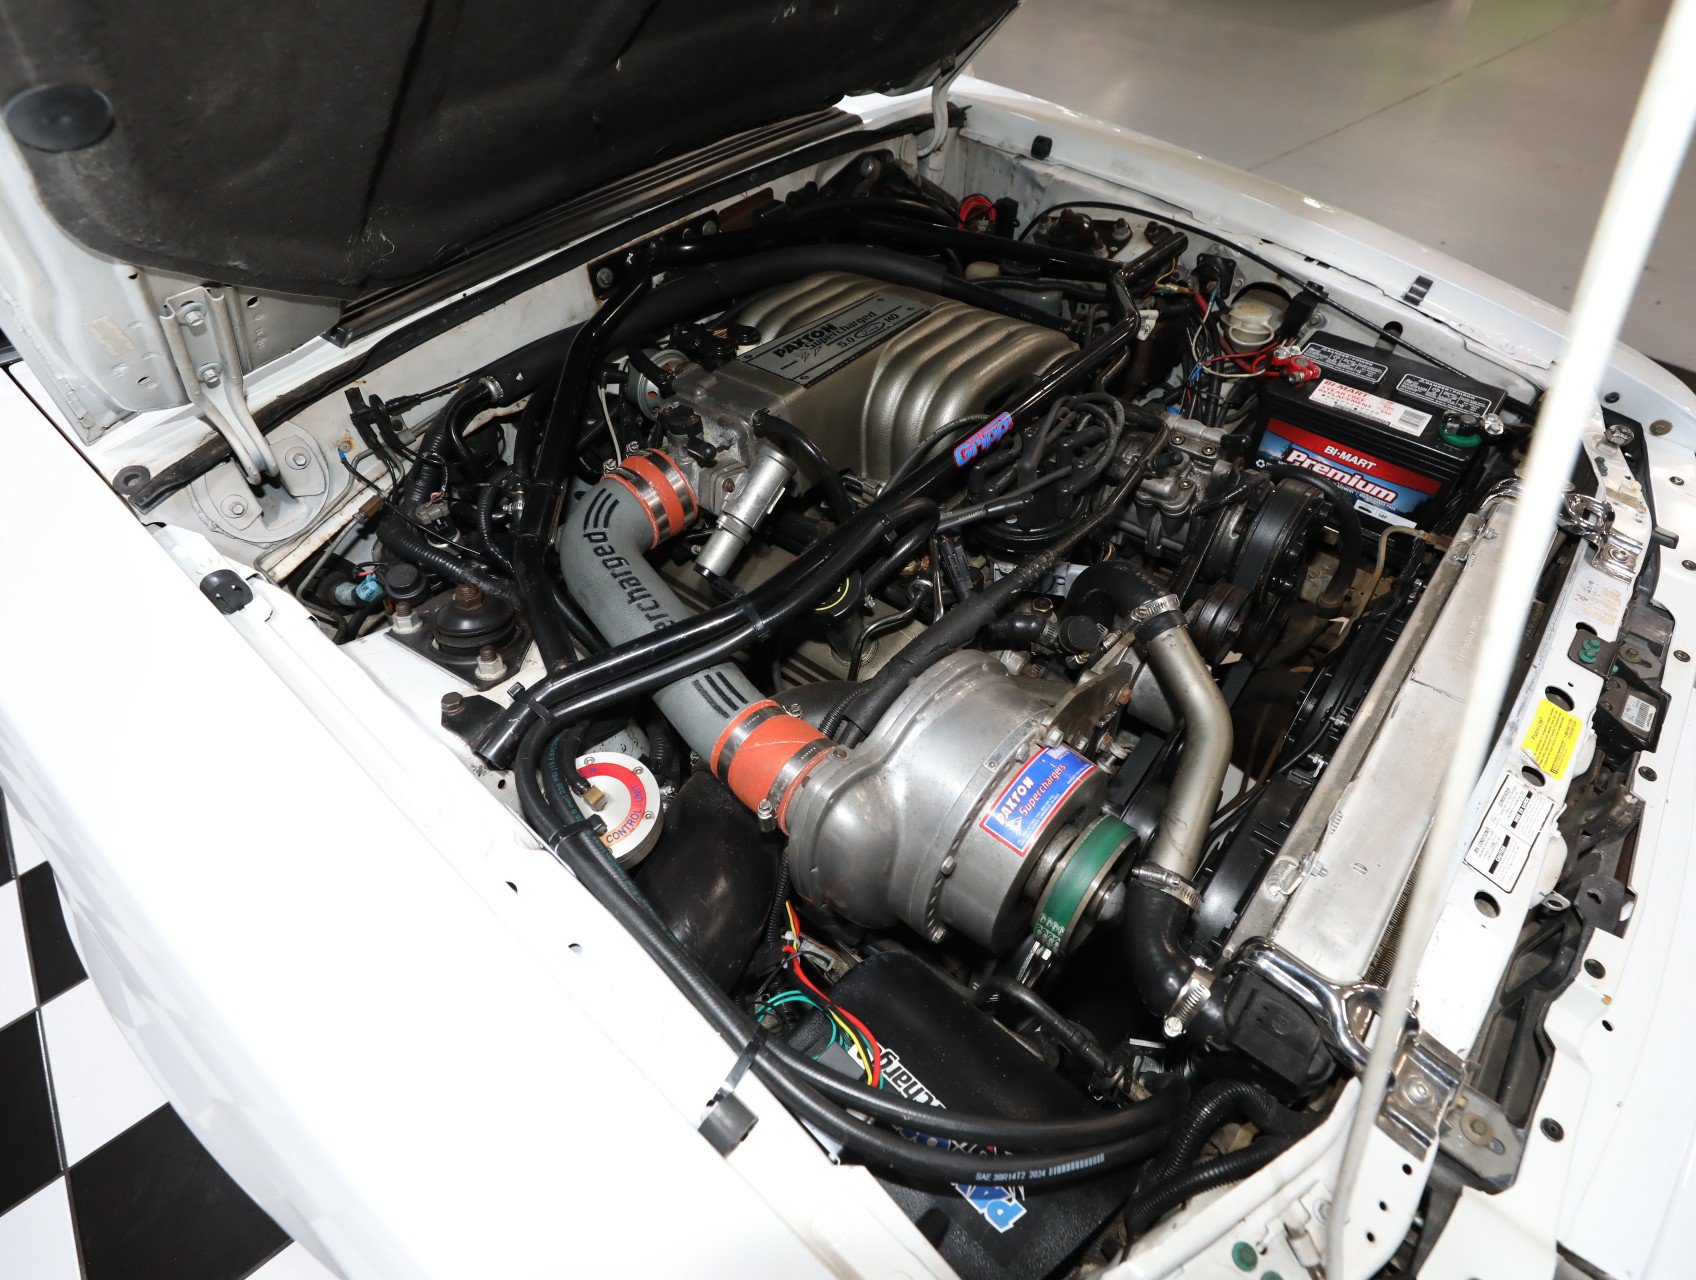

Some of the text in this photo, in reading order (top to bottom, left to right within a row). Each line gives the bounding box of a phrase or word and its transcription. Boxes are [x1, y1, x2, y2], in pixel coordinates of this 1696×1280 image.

[773, 323, 837, 358] PAXTON
[804, 311, 877, 350] Supercharged
[837, 336, 855, 348] 5.0
[884, 313, 899, 322] HO
[1318, 388, 1372, 409] REPLACEMENT
[1286, 449, 1398, 504] Premium
[995, 776, 1035, 826] PAXTON
[1018, 764, 1067, 816] Superchargers
[606, 808, 643, 844] CONTROL
[975, 1169, 1046, 1181] SAE 30R14T2 2024
